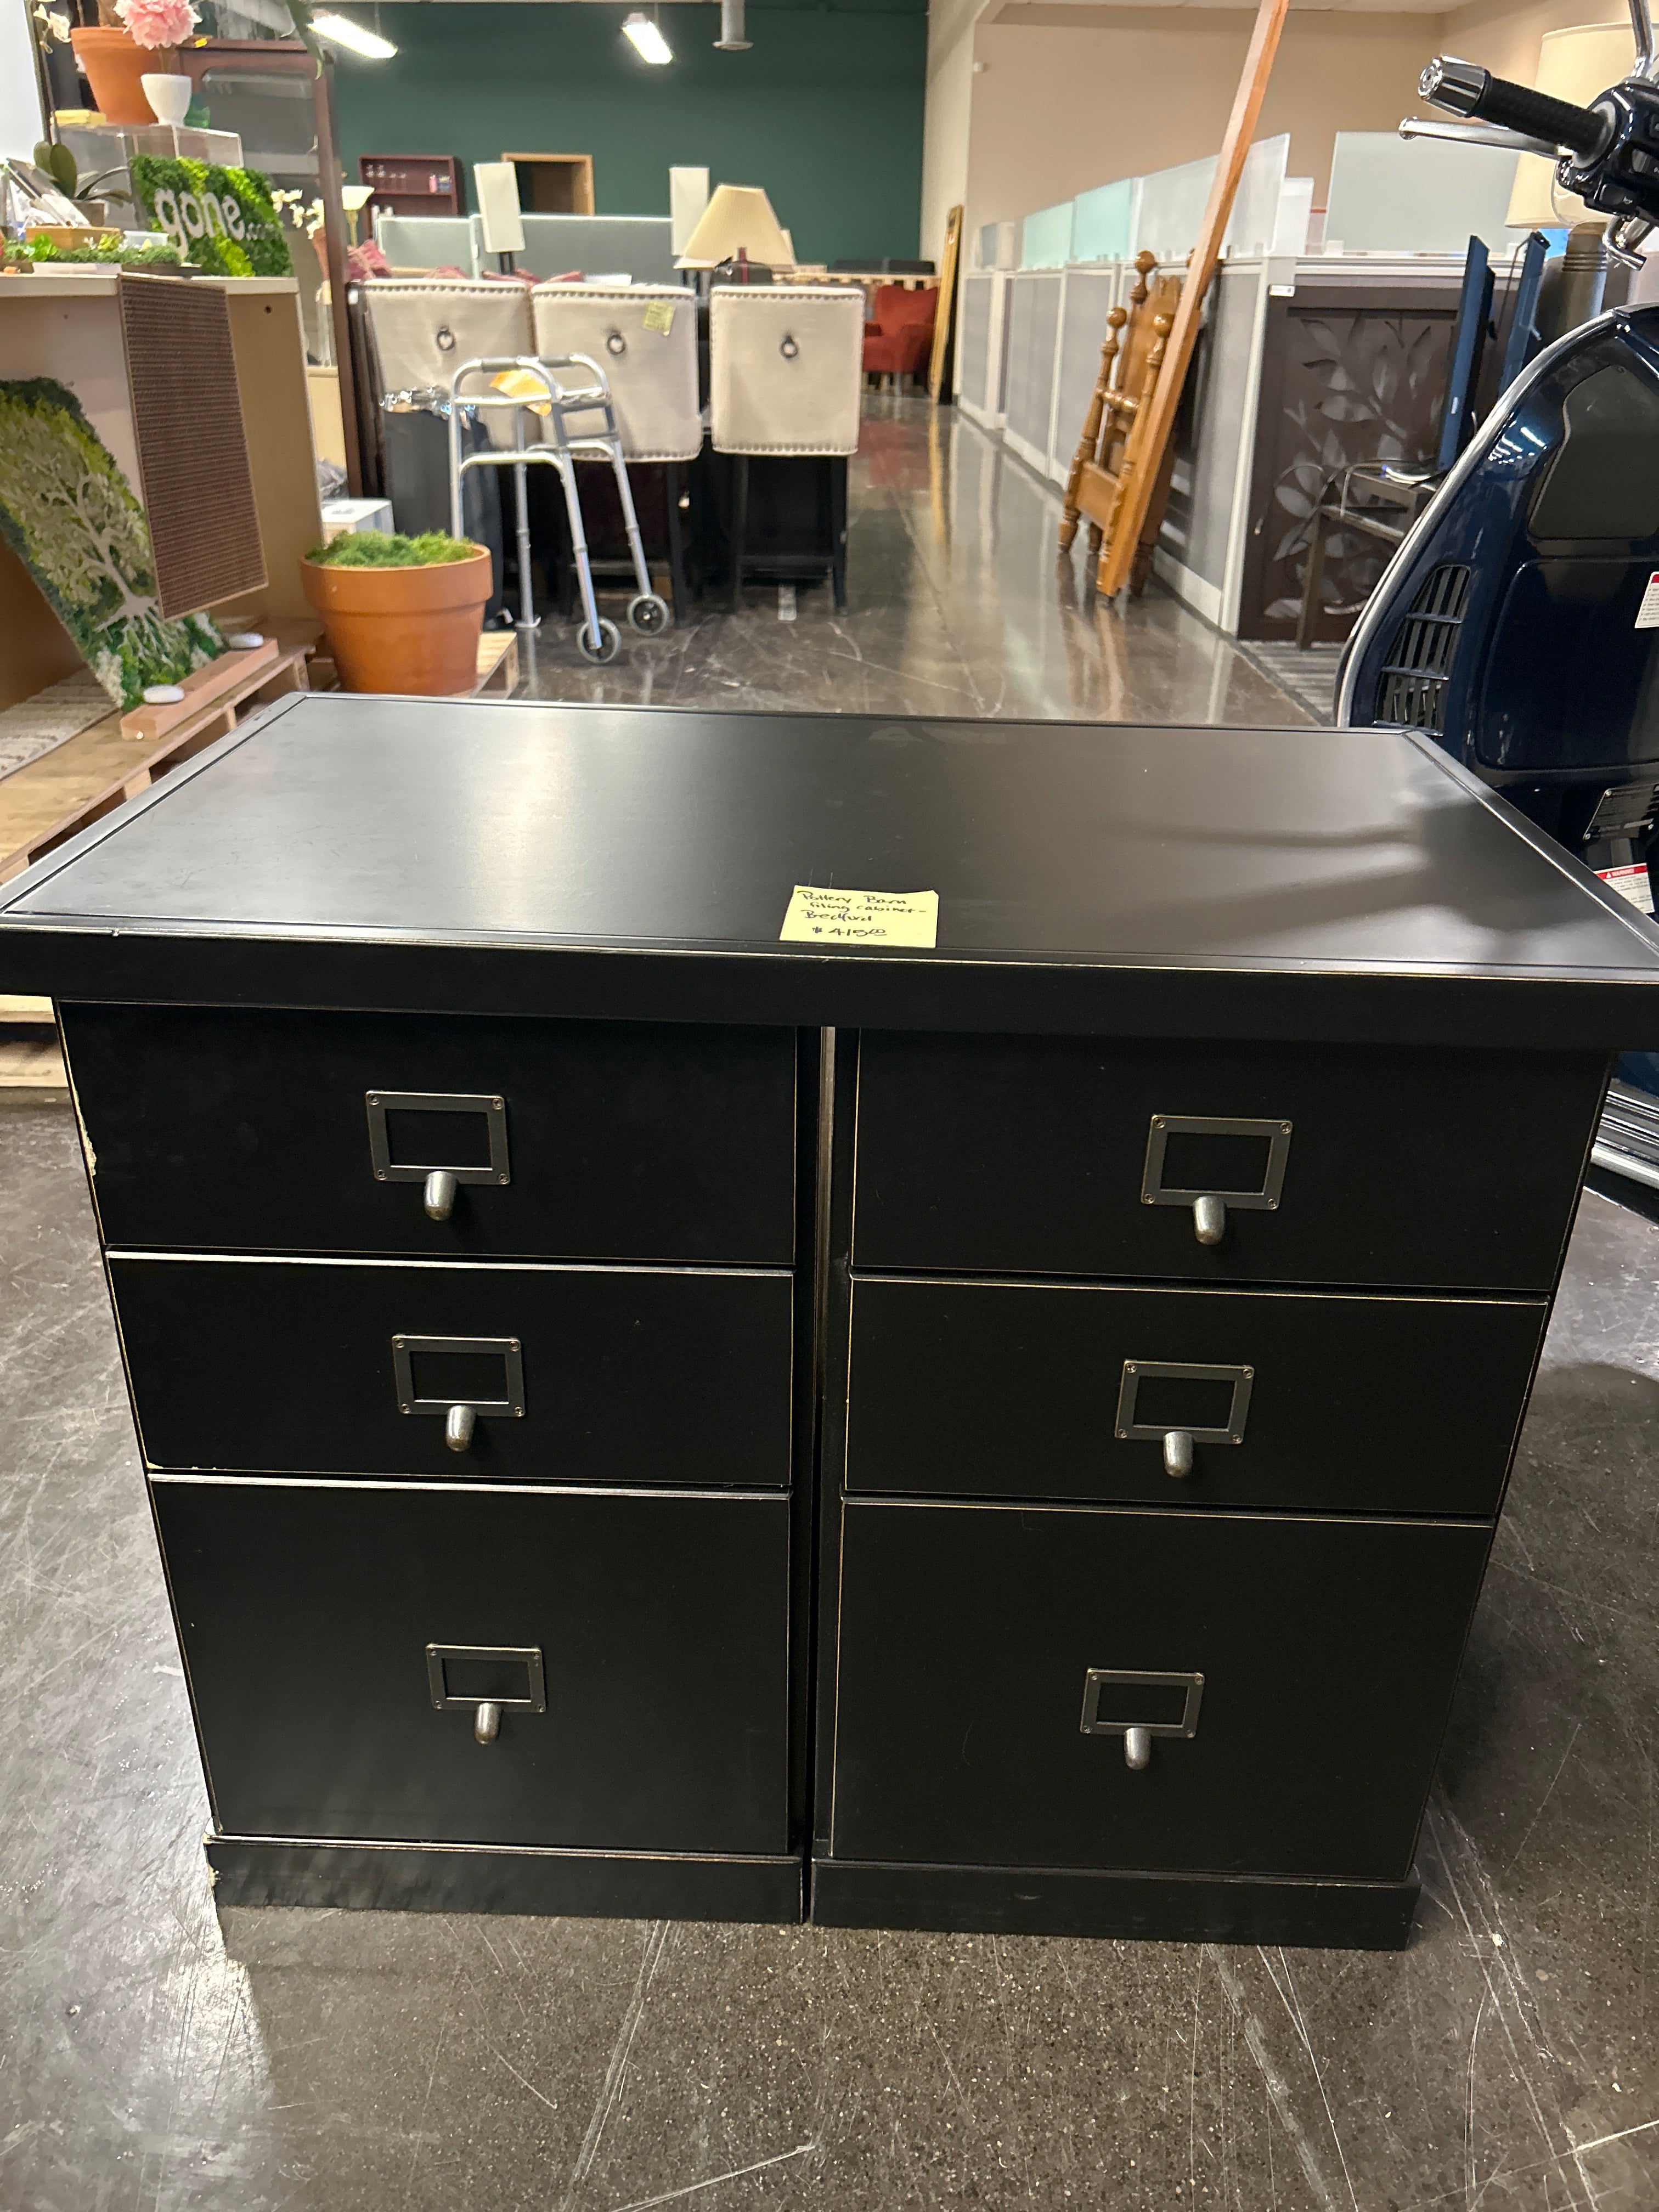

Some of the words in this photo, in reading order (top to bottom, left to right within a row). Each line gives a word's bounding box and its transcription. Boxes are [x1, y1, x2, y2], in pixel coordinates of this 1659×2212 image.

[797, 890, 851, 904] Pottery
[863, 895, 906, 904] Barn
[810, 902, 850, 913] filing
[800, 910, 872, 922] Bedford
